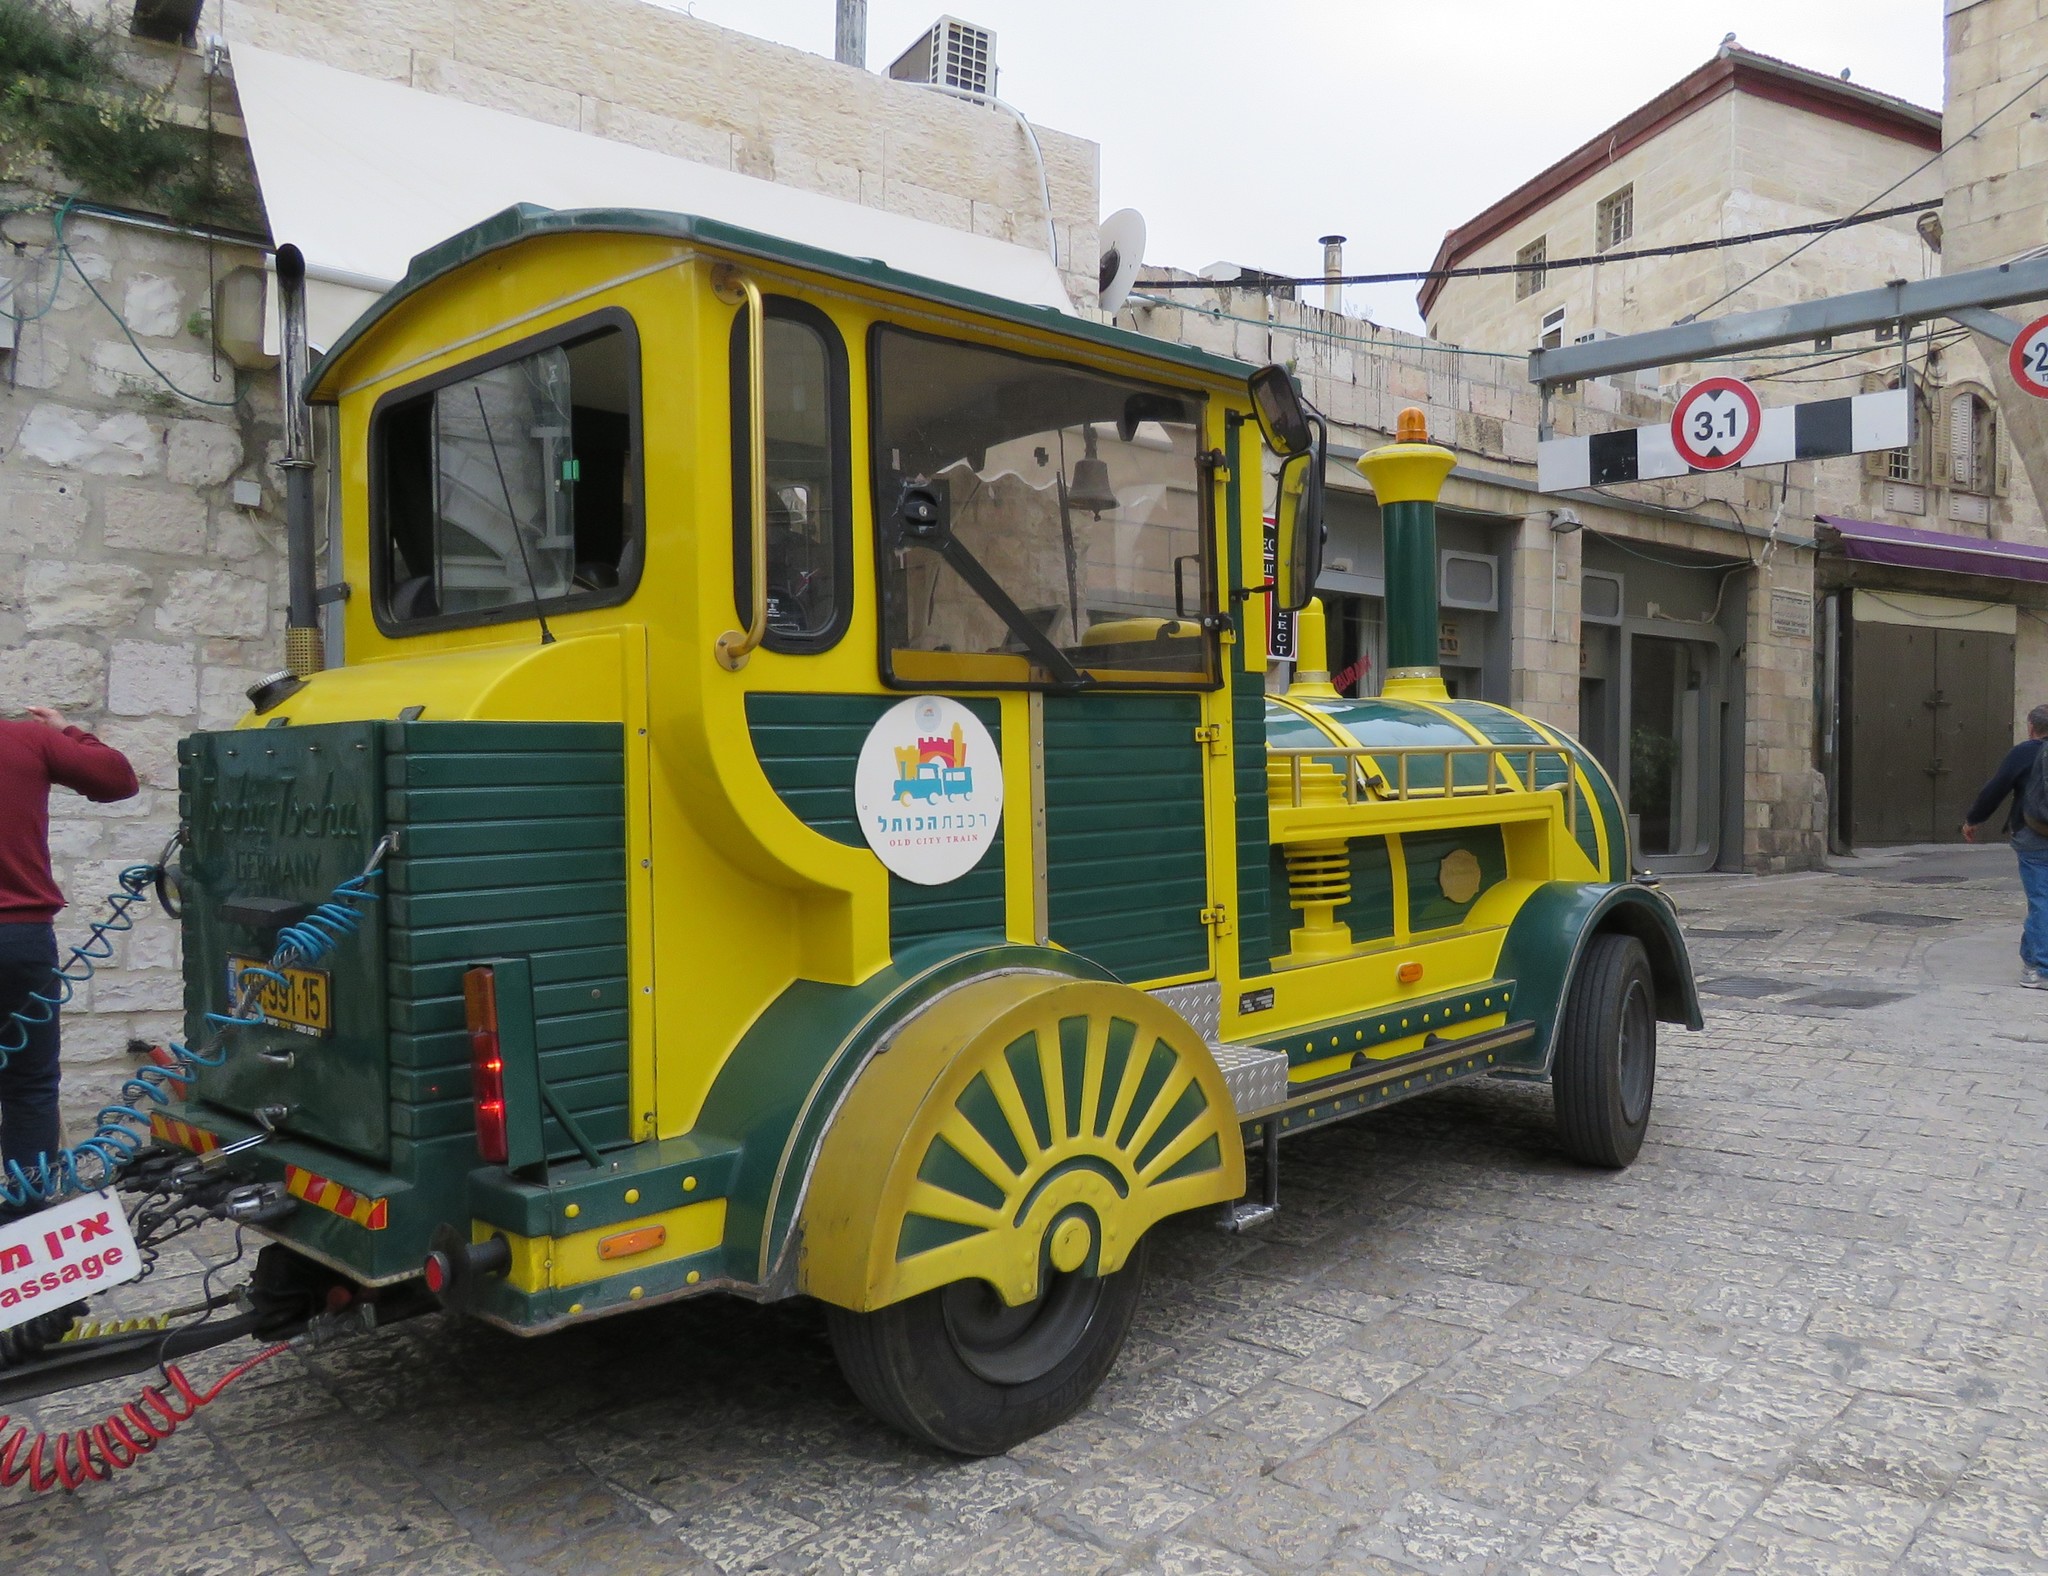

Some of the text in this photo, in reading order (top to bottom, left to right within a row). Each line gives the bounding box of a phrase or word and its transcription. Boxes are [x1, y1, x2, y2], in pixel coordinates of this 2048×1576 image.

[1694, 408, 1736, 441] 3.1
[889, 834, 978, 847] OLD CITY TRAIN
[44, 1211, 114, 1260] אין
